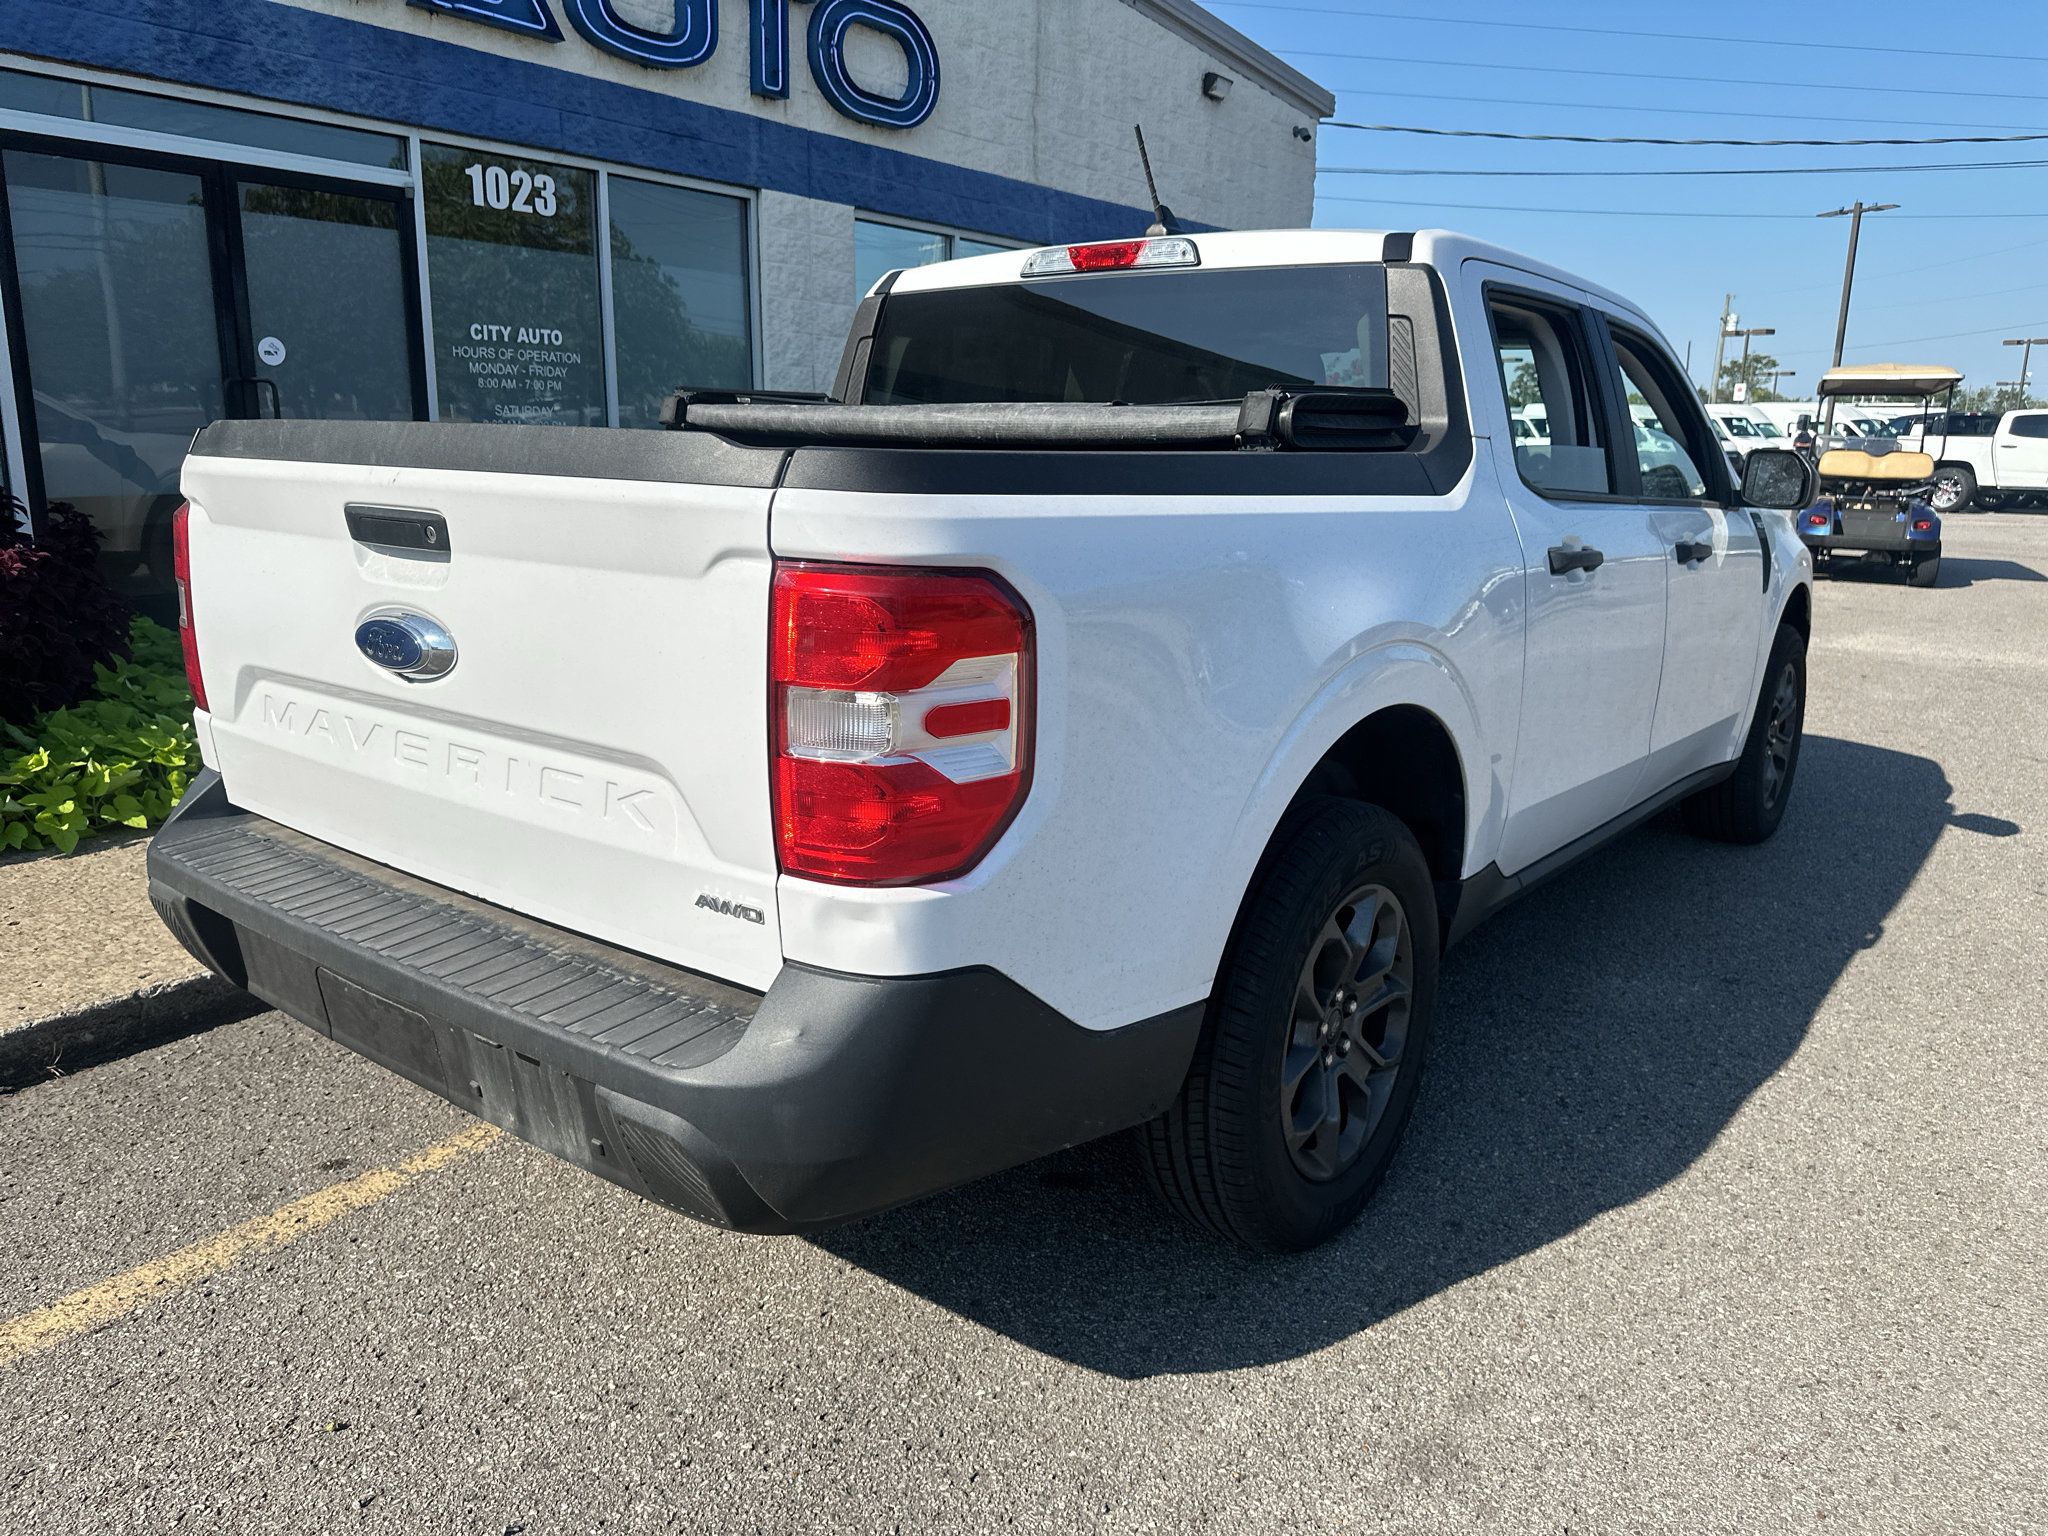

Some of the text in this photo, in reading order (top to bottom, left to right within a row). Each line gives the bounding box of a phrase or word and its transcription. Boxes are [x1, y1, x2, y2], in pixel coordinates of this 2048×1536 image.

[405, 0, 941, 130] UTO
[464, 163, 557, 217] 1023
[470, 323, 563, 345] CITY AUTO
[452, 345, 581, 364] HOURS OF OPERATION
[469, 361, 520, 375] MONDAY
[529, 364, 568, 377] FRIDAY
[477, 377, 499, 389] 8:00
[500, 378, 517, 389] AM
[525, 379, 545, 390] 7:00
[547, 380, 562, 391] PM
[494, 403, 555, 417] SATURDAY
[262, 693, 657, 833] MAVERICK
[694, 893, 765, 925] AWD
